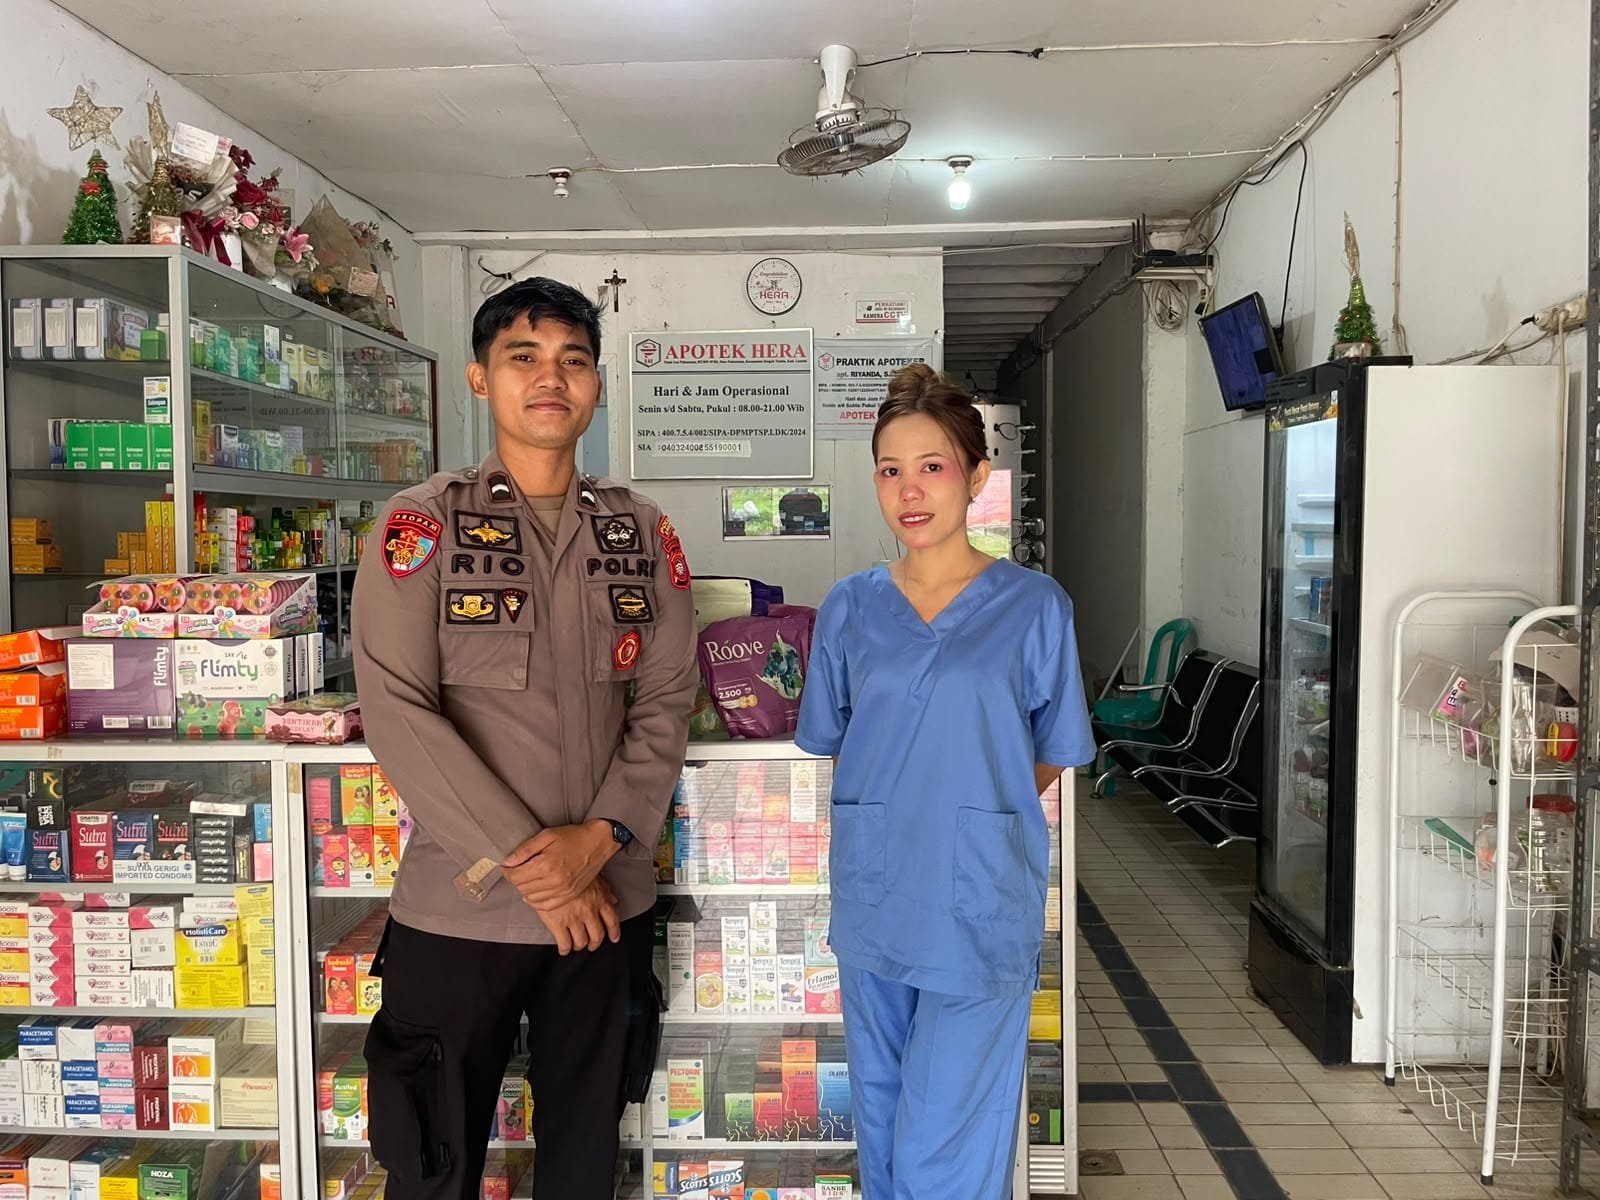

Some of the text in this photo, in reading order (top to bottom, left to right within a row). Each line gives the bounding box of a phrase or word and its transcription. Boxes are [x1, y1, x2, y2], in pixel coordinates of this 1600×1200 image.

[760, 291, 789, 299] HERA
[665, 343, 806, 359] APOTEK HERA
[836, 358, 875, 366] PRAKTIK
[654, 385, 789, 398] Hari & Jam Operasional
[638, 405, 662, 413] Senin
[664, 405, 675, 413] s/d
[677, 405, 704, 414] Sabtu,
[706, 404, 731, 413] Pukul
[738, 404, 785, 412] 08.00-21.00
[787, 404, 805, 412] Wib
[839, 411, 876, 420] APOTEK
[637, 429, 656, 437] SIPA
[638, 443, 652, 451] SIA
[395, 514, 438, 532] PROPAM
[451, 553, 525, 576] RIO
[153, 646, 169, 686] flimty
[200, 659, 258, 681] flimty
[79, 827, 107, 843] Sutra
[117, 821, 148, 838] Sutra
[157, 820, 189, 838] Sutra
[33, 831, 59, 846] Sutra
[185, 926, 226, 936] HolistiCare
